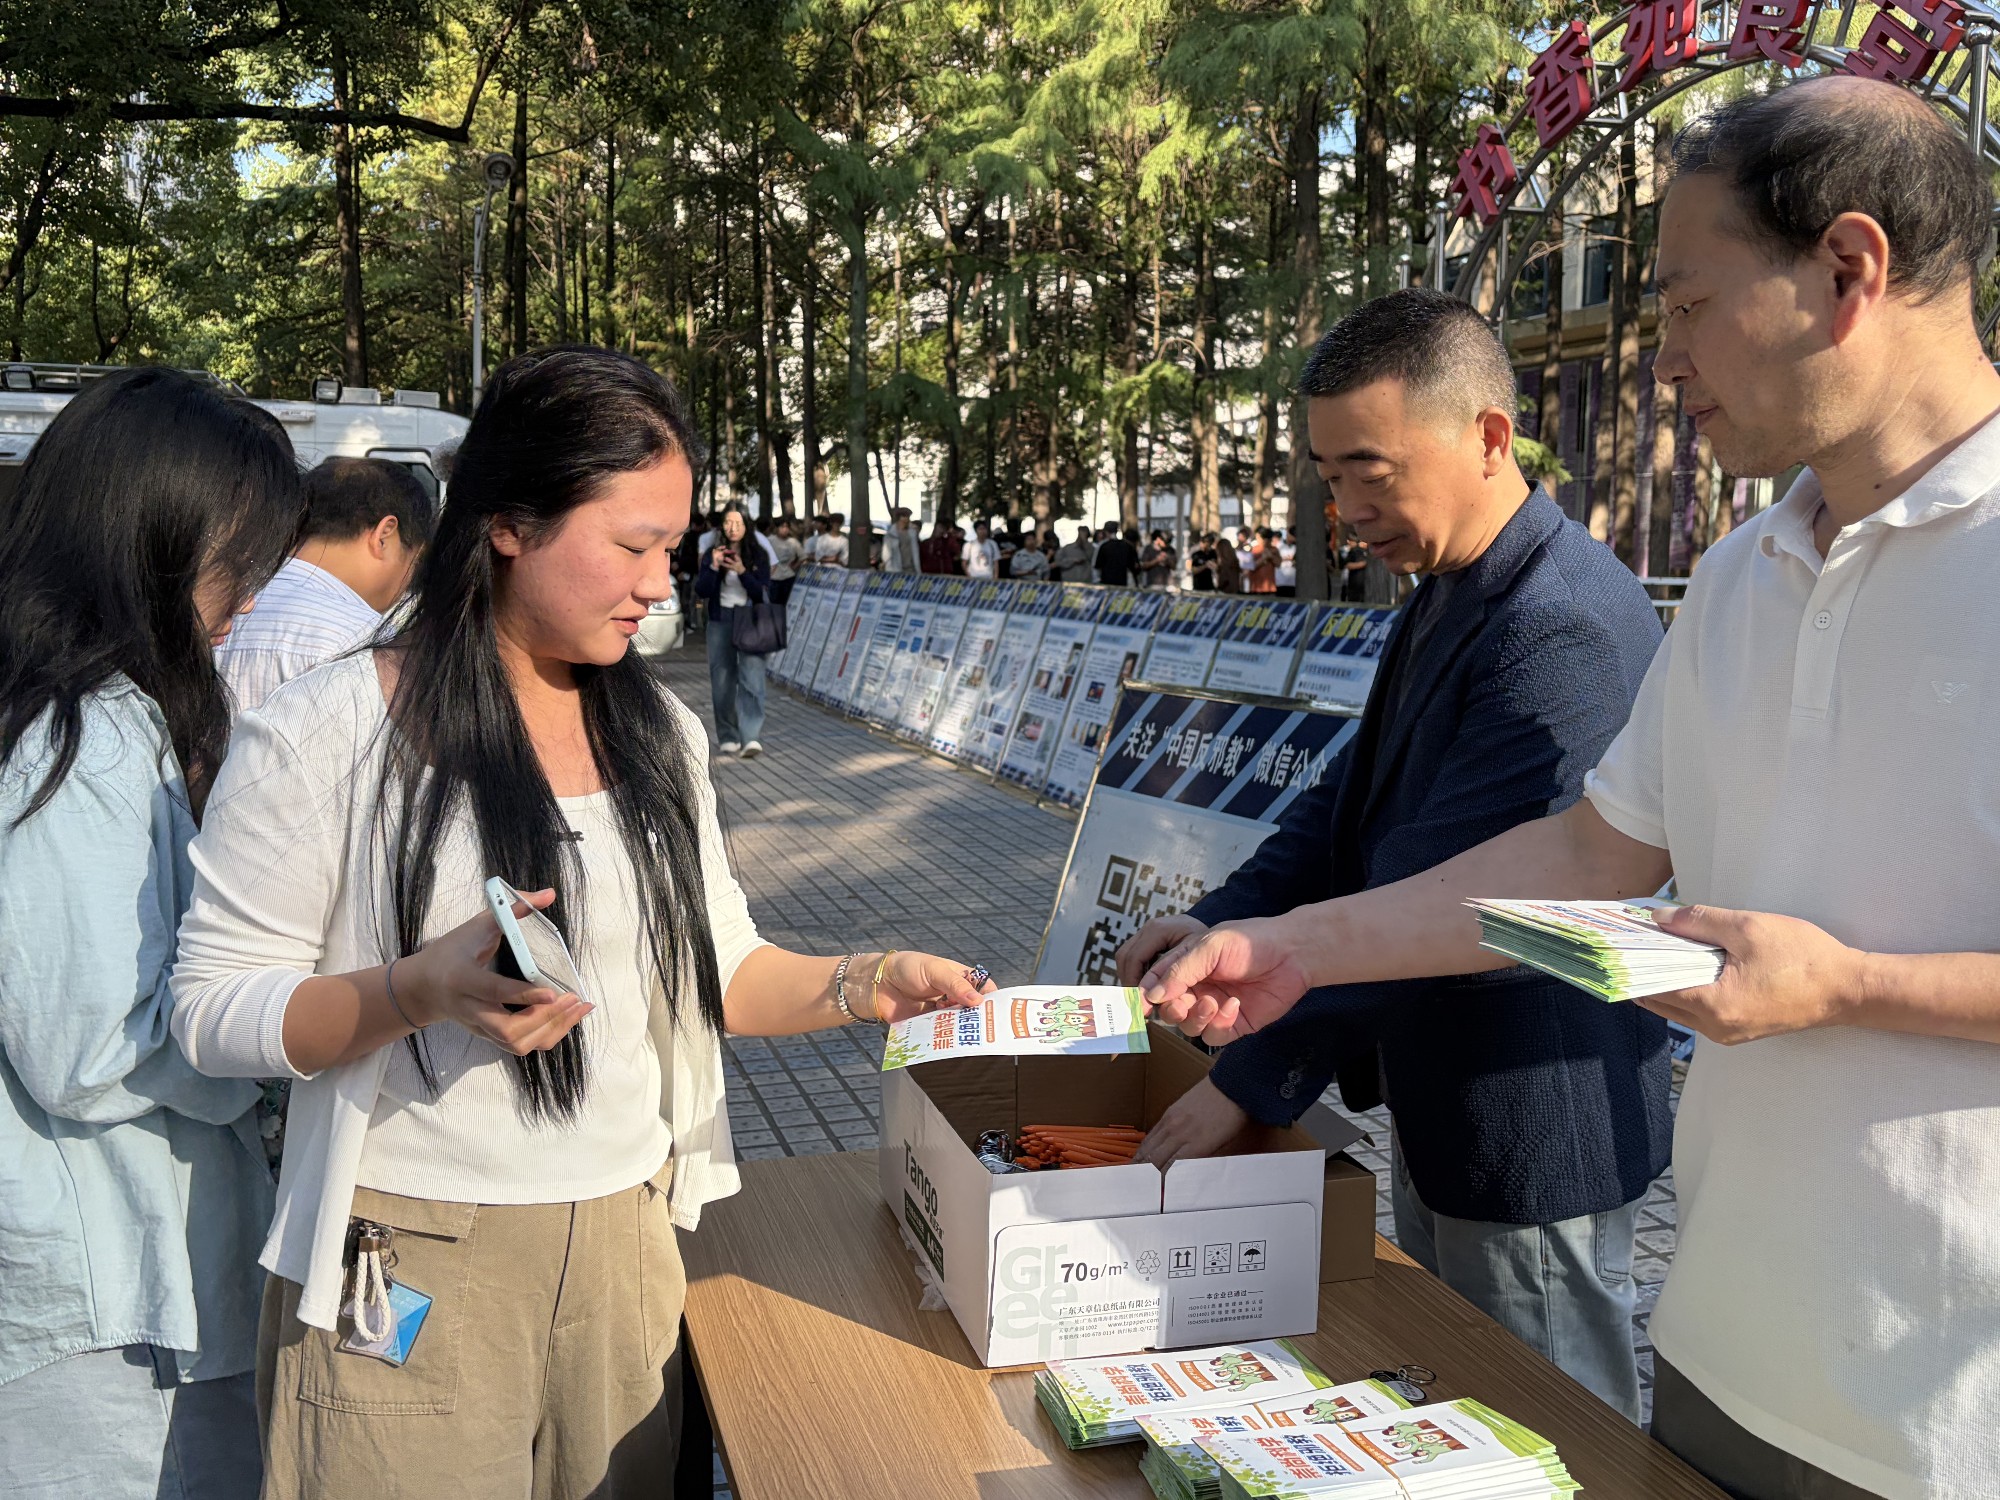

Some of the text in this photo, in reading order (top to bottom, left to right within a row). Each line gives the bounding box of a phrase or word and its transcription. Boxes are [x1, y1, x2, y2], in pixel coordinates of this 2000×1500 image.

[1122, 720, 1330, 792] 关注“中国反邪教”微信公众
[903, 1138, 938, 1217] Tango
[1059, 1298, 1160, 1316] 广东天章信息纸品有限公司
[1102, 1366, 1152, 1406] 崇尚科学
[1126, 1364, 1177, 1402] 拒绝邪教
[1255, 1436, 1324, 1480] 崇尚科学
[1283, 1434, 1356, 1477] 拒绝邪教
